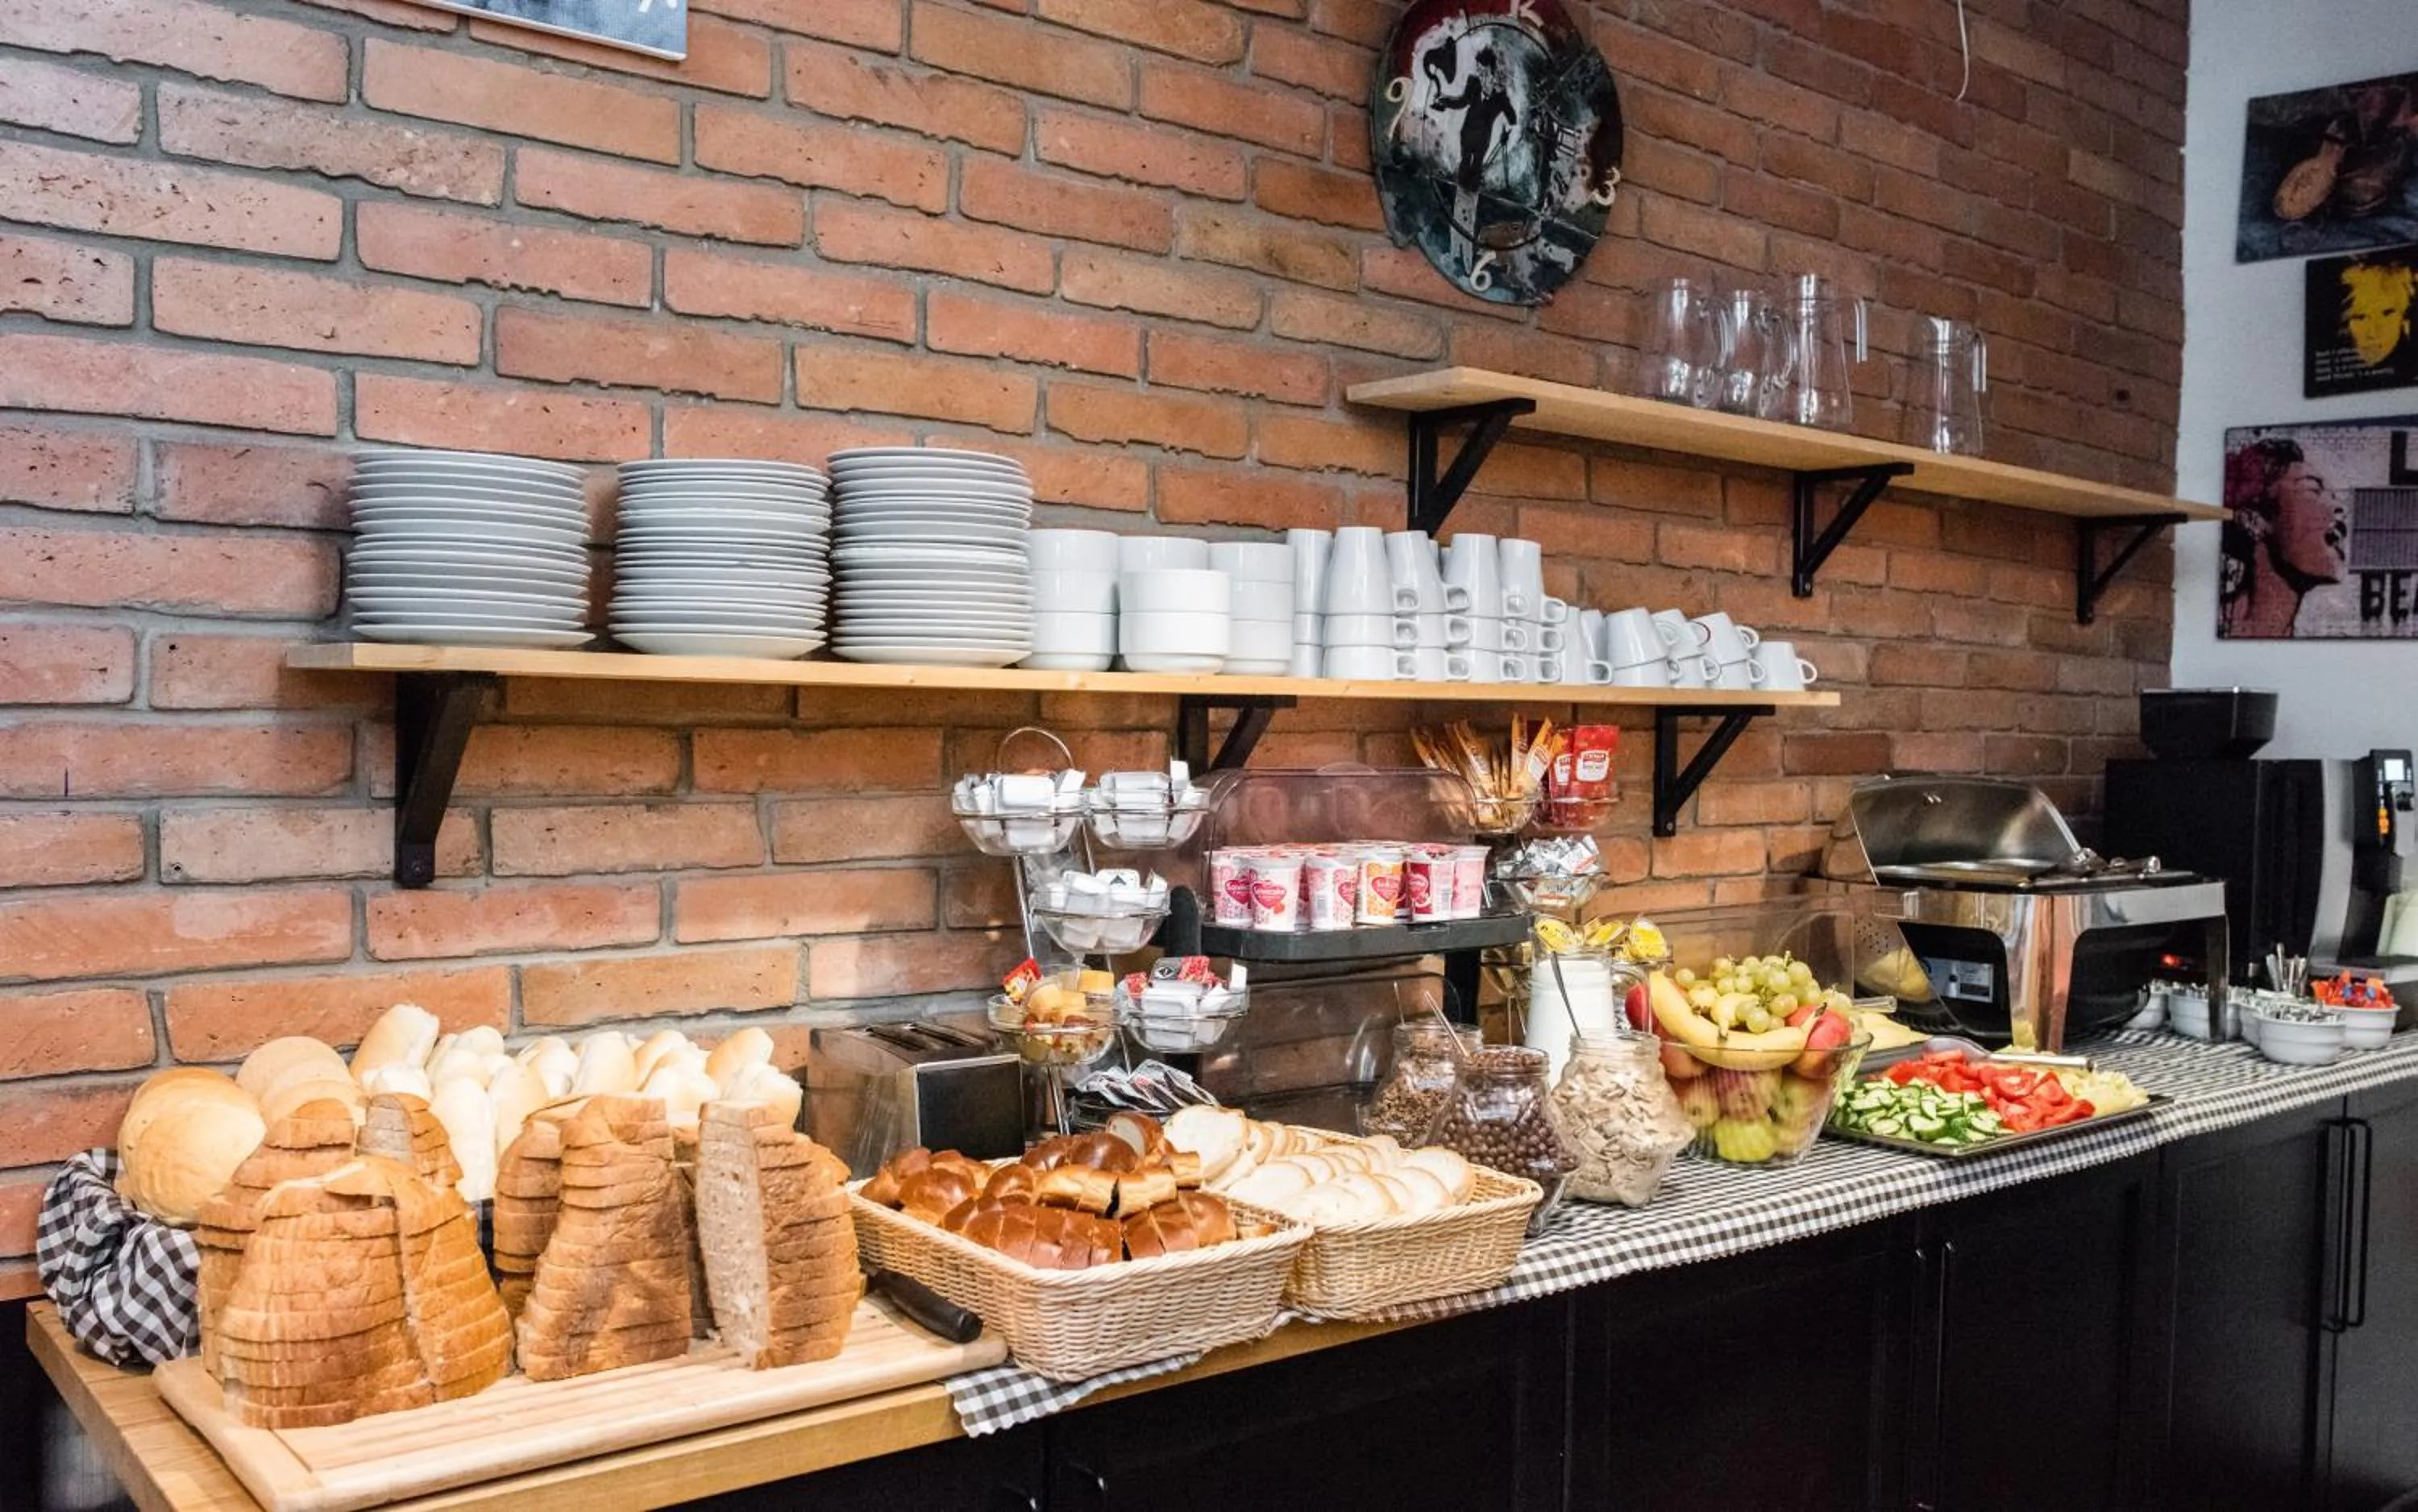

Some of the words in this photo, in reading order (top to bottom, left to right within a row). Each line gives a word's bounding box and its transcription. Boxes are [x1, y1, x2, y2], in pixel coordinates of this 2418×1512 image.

[1387, 77, 1414, 140] 9
[1590, 167, 1622, 207] 3
[1469, 250, 1498, 293] 6
